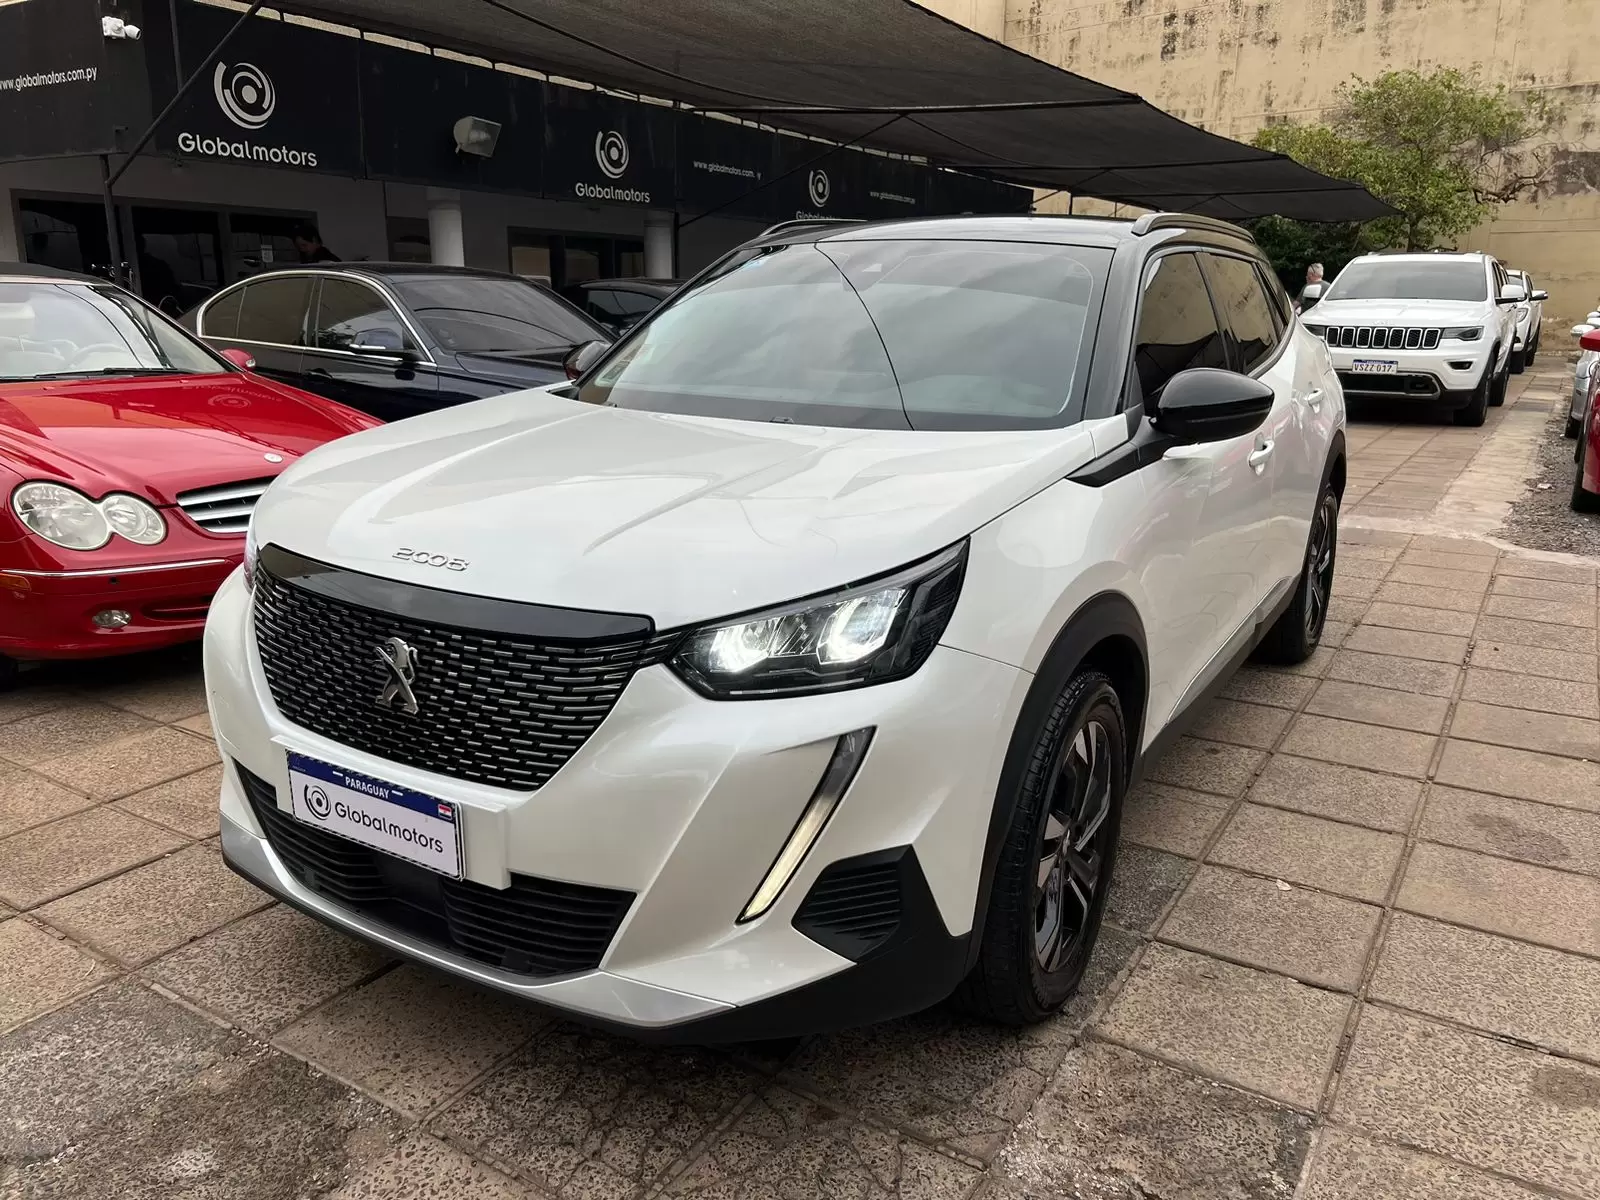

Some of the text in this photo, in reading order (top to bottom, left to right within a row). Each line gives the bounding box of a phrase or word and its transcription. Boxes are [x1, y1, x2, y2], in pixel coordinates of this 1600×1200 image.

[178, 132, 318, 167] Globalmotors
[575, 182, 651, 204] Globalmotors
[391, 547, 470, 572] 2008
[344, 776, 390, 800] PARAGUAY
[334, 801, 444, 854] Globalmotors
